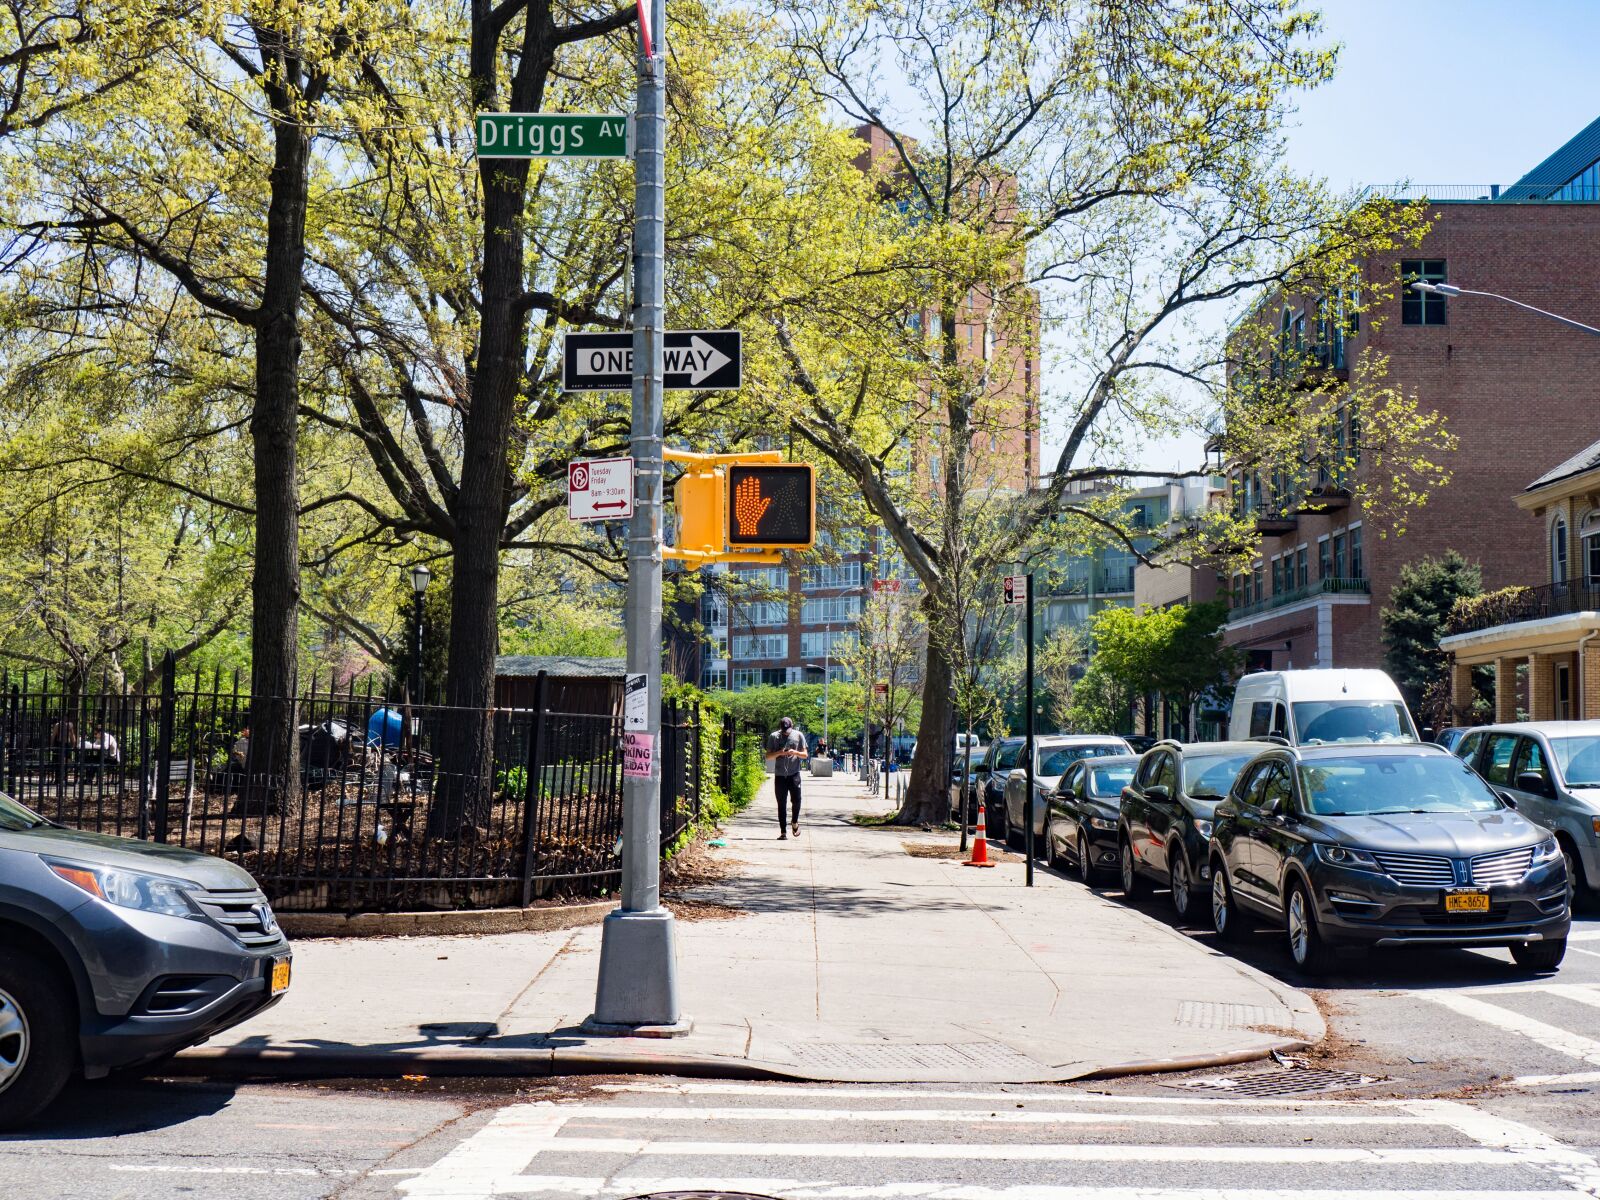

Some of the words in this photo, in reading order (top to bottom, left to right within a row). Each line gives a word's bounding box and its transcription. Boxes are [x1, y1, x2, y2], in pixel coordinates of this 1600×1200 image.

[481, 117, 584, 154] Driggs
[600, 121, 625, 138] Av
[590, 351, 633, 372] ONE
[663, 350, 713, 371] WAY
[591, 467, 611, 476] Tuesday
[591, 476, 606, 485] Friday
[591, 489, 602, 497] 8am
